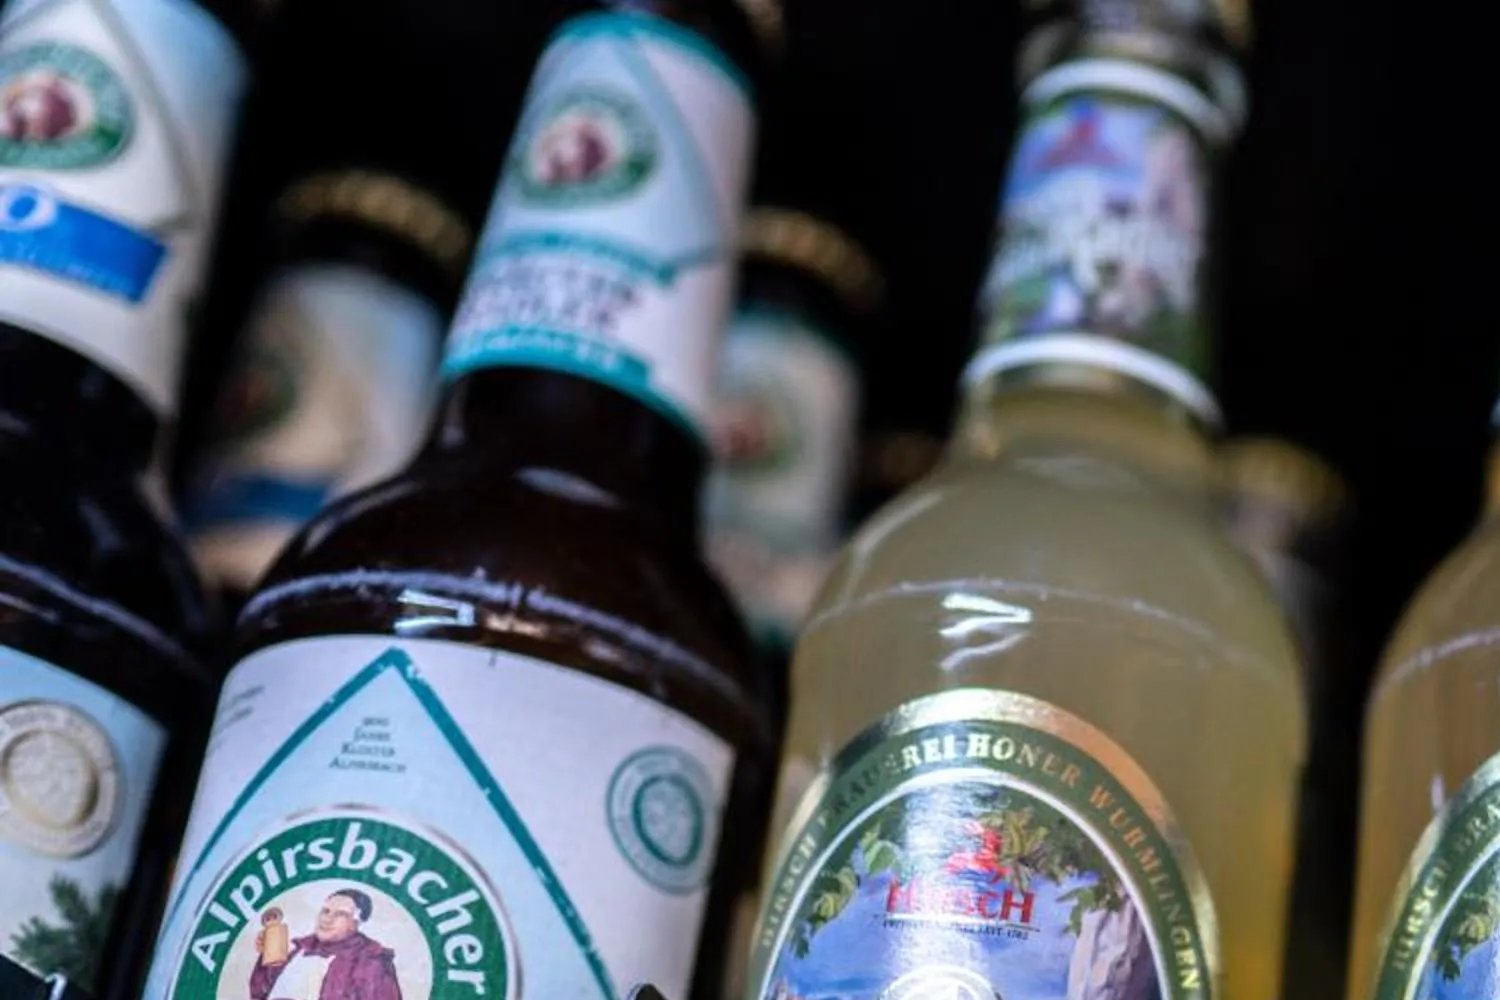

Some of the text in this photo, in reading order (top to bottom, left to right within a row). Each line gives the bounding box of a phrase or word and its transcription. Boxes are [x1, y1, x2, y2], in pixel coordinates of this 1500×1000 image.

[190, 819, 487, 998] Alpirsbacher
[967, 733, 1081, 790] HONER
[1089, 784, 1201, 992] WURMLINGEN
